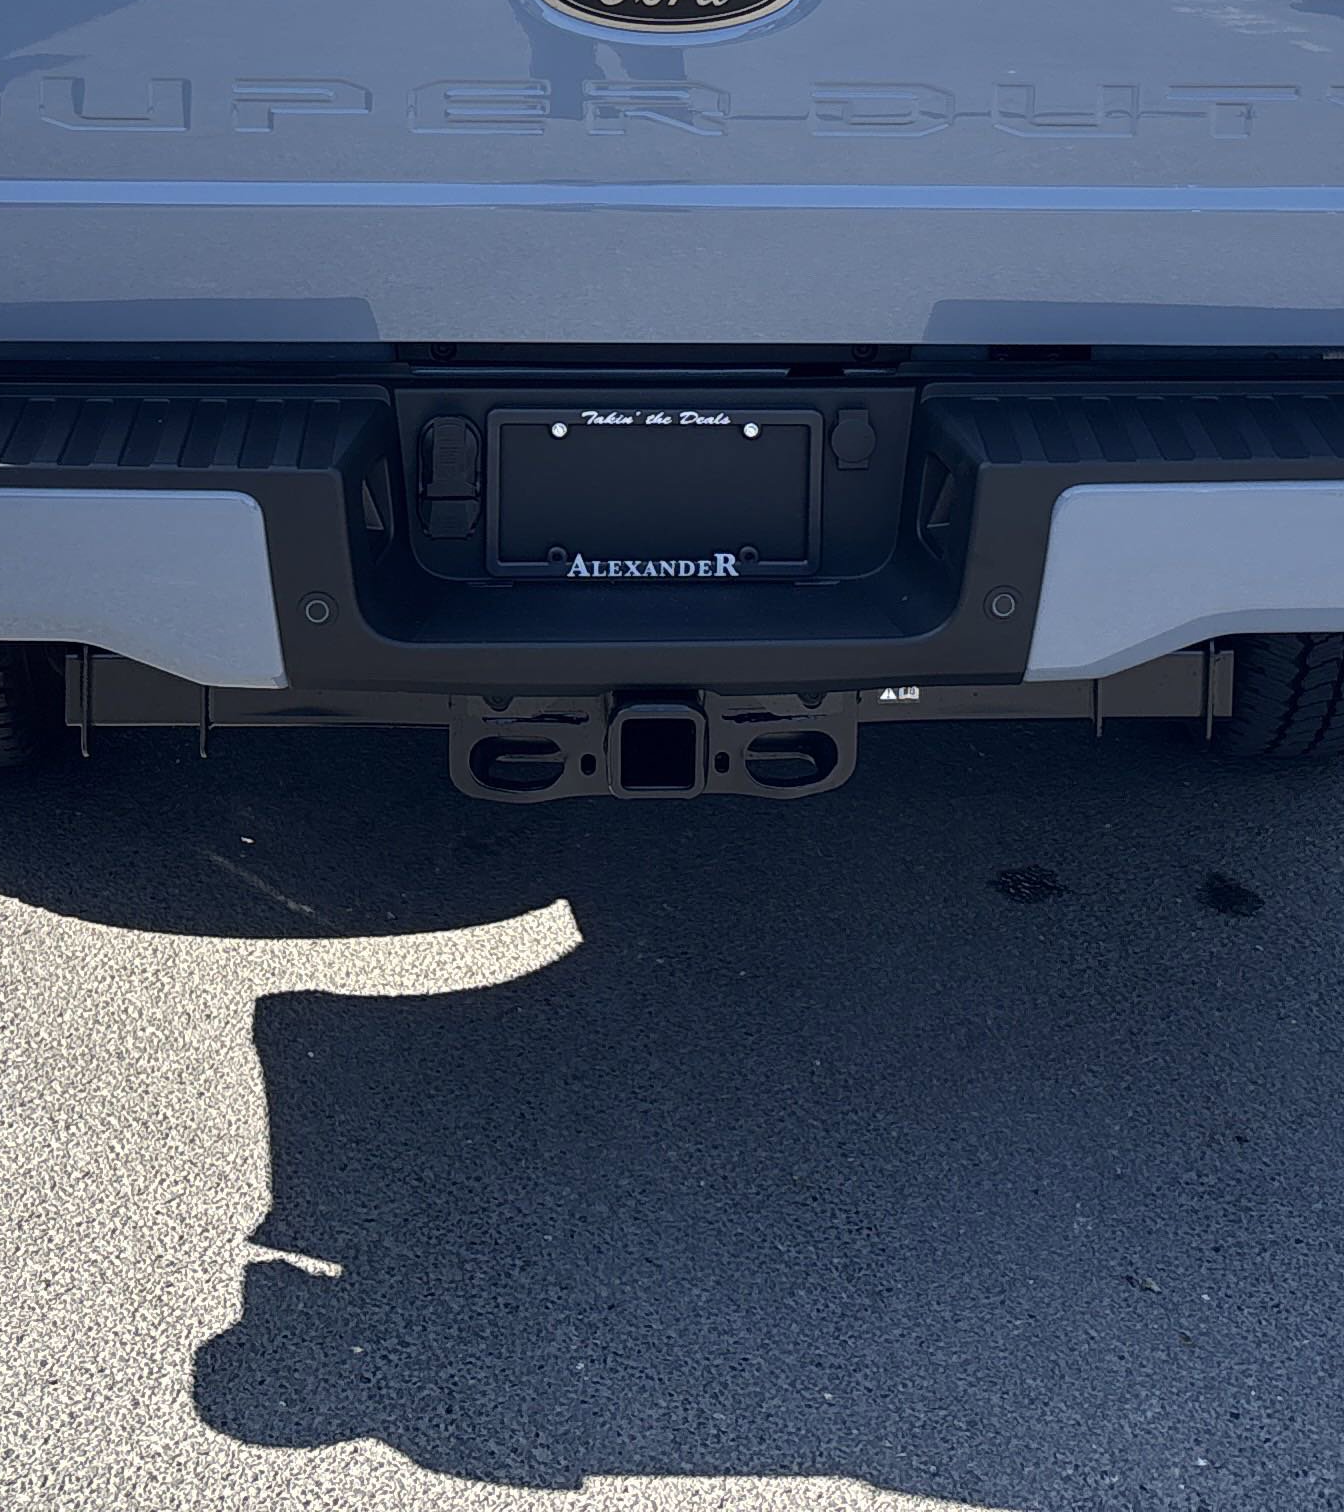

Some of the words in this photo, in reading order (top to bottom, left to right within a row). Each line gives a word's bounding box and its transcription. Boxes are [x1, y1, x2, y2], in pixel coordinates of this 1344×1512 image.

[581, 410, 641, 425] Takin'
[645, 411, 672, 425] the
[679, 411, 731, 425] Deals
[567, 552, 740, 577] ALEXANDER
